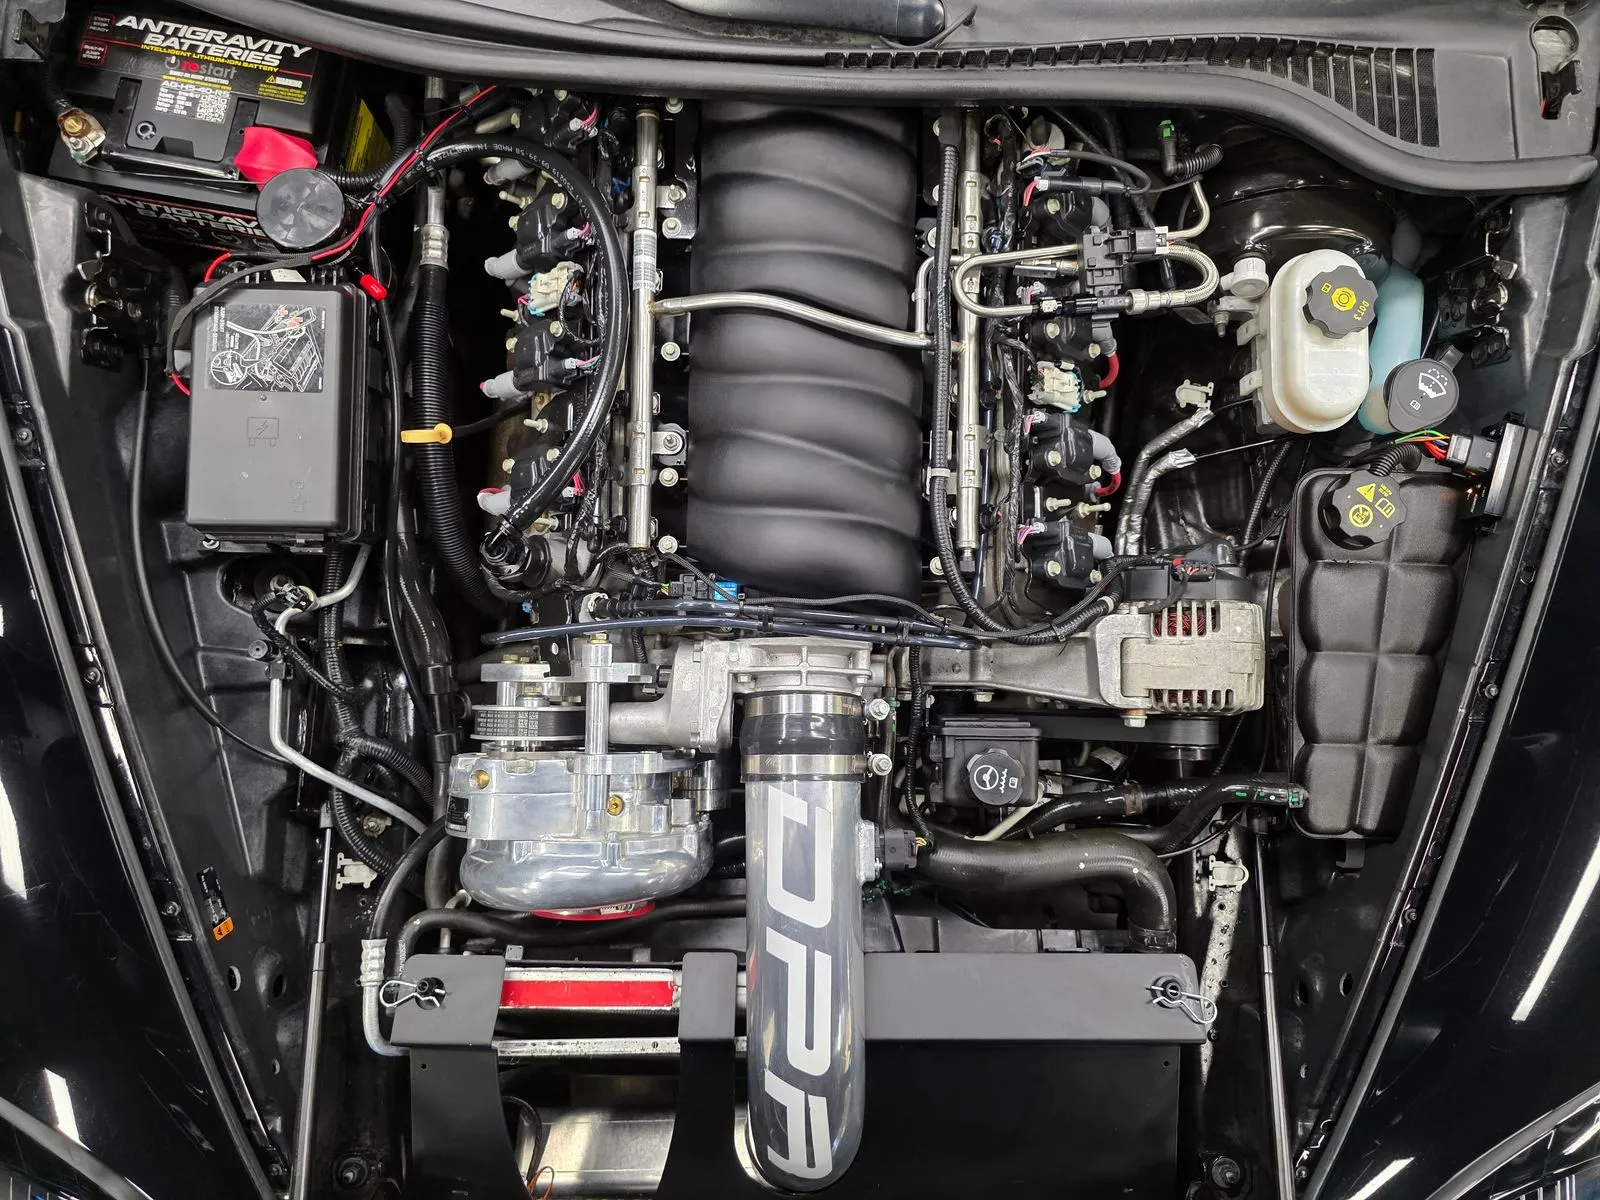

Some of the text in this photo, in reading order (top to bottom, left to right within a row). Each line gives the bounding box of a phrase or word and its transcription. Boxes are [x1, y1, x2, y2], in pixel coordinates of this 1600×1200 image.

[115, 15, 312, 58] ANTIGRAVITY
[143, 32, 282, 67] BATTERIES
[140, 44, 279, 73] INTELLIGENT LITHIUM-ION BATTERY
[181, 60, 238, 80] restart
[493, 143, 513, 153] MADE
[100, 194, 261, 228] ANTIGRAV
[136, 208, 268, 237] BATTERIE
[1353, 300, 1370, 321] DOT 3
